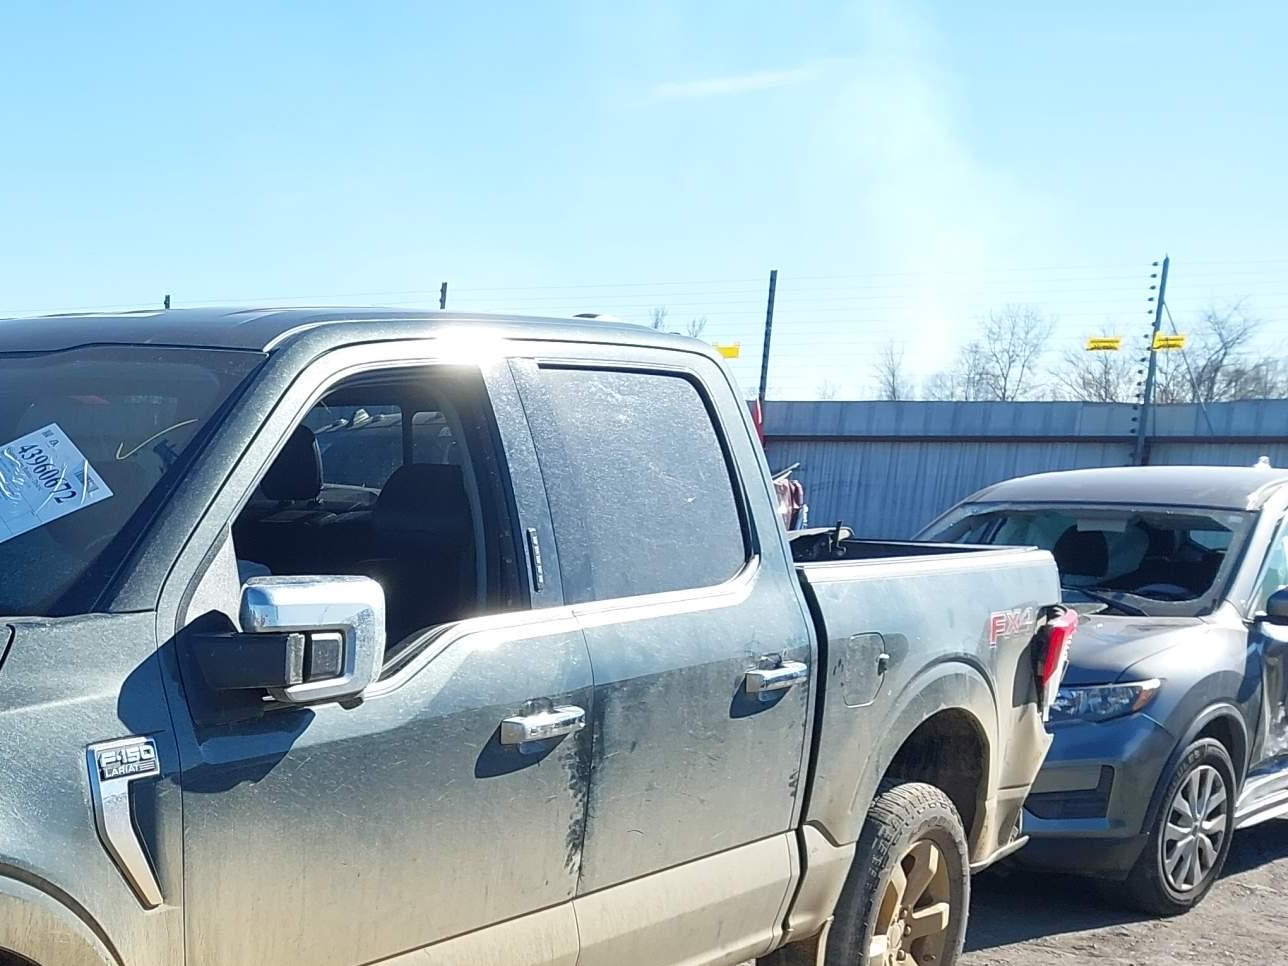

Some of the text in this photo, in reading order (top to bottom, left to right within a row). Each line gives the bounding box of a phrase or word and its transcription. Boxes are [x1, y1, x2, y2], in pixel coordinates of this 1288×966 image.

[18, 444, 78, 504] 43960672
[989, 607, 1033, 648] FX4
[100, 745, 155, 768] F-150
[105, 765, 138, 778] LARIAT
